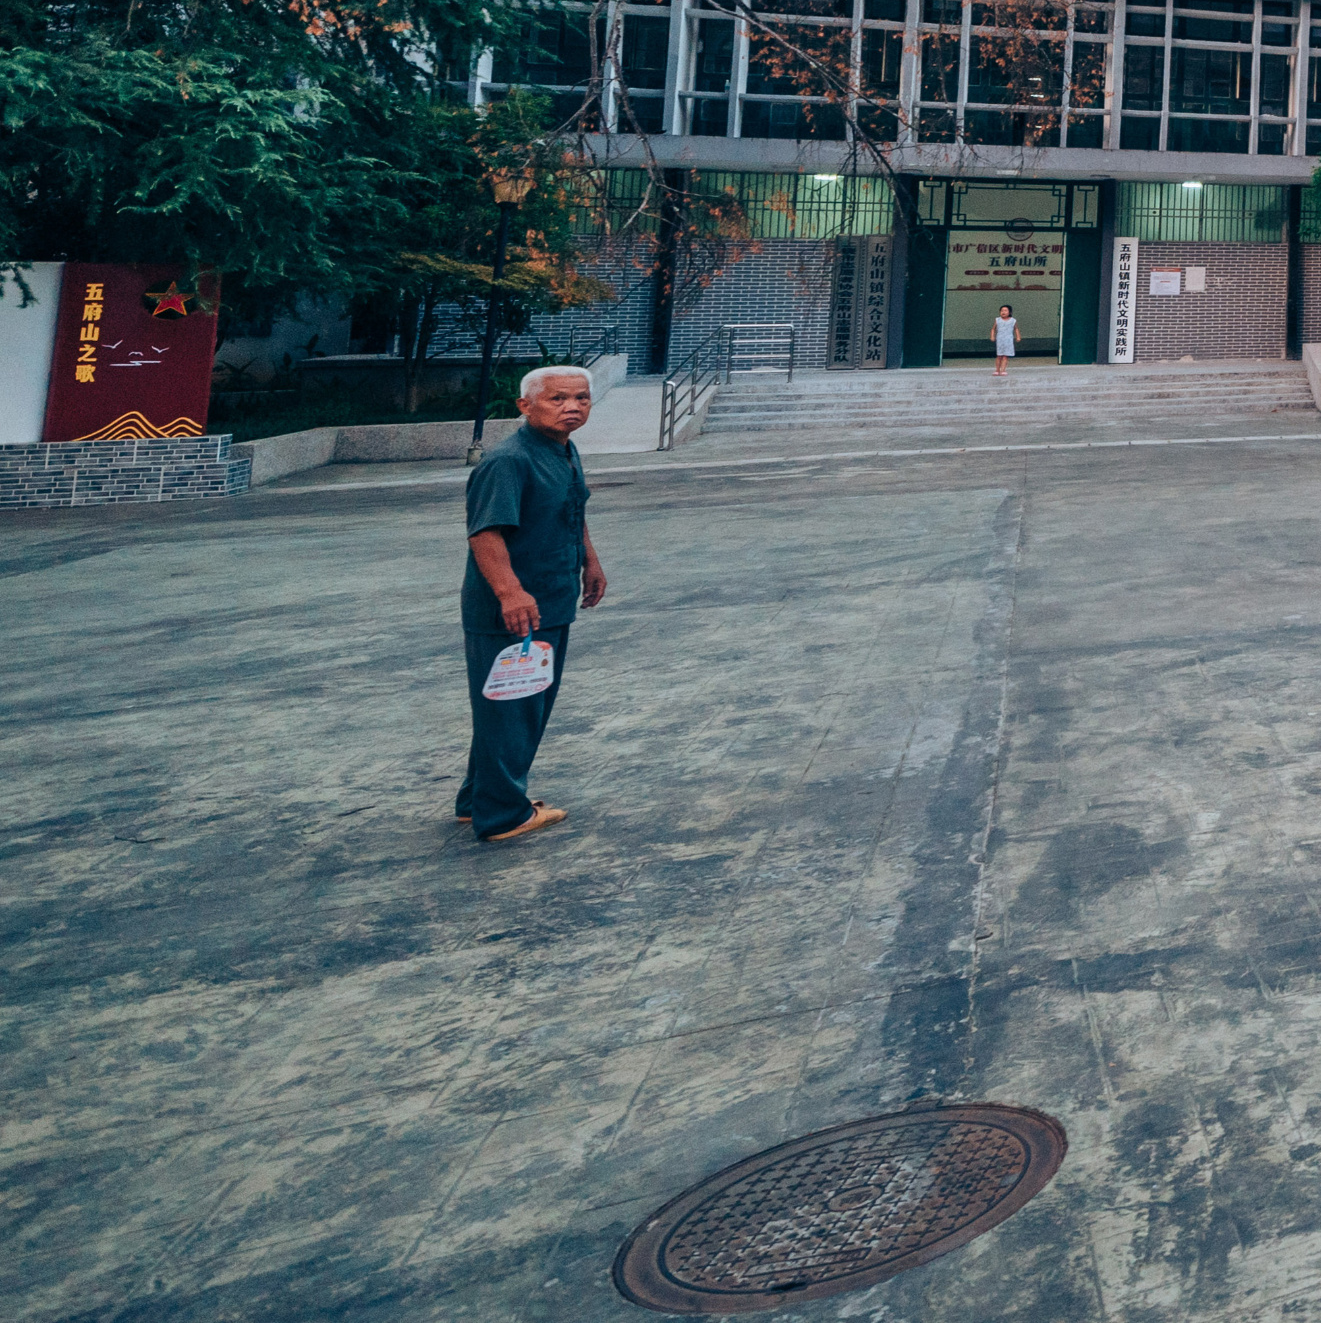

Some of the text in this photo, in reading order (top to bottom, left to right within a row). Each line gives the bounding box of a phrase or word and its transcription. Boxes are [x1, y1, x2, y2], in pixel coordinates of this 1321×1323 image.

[948, 243, 1063, 254] 市广信区新时代文明
[988, 255, 1047, 267] 五府山所
[75, 283, 104, 383] 五府山之歌
[865, 242, 886, 361] 五府山镇综合文化站
[1115, 243, 1132, 356] 五府山镇新时代文明实践所
